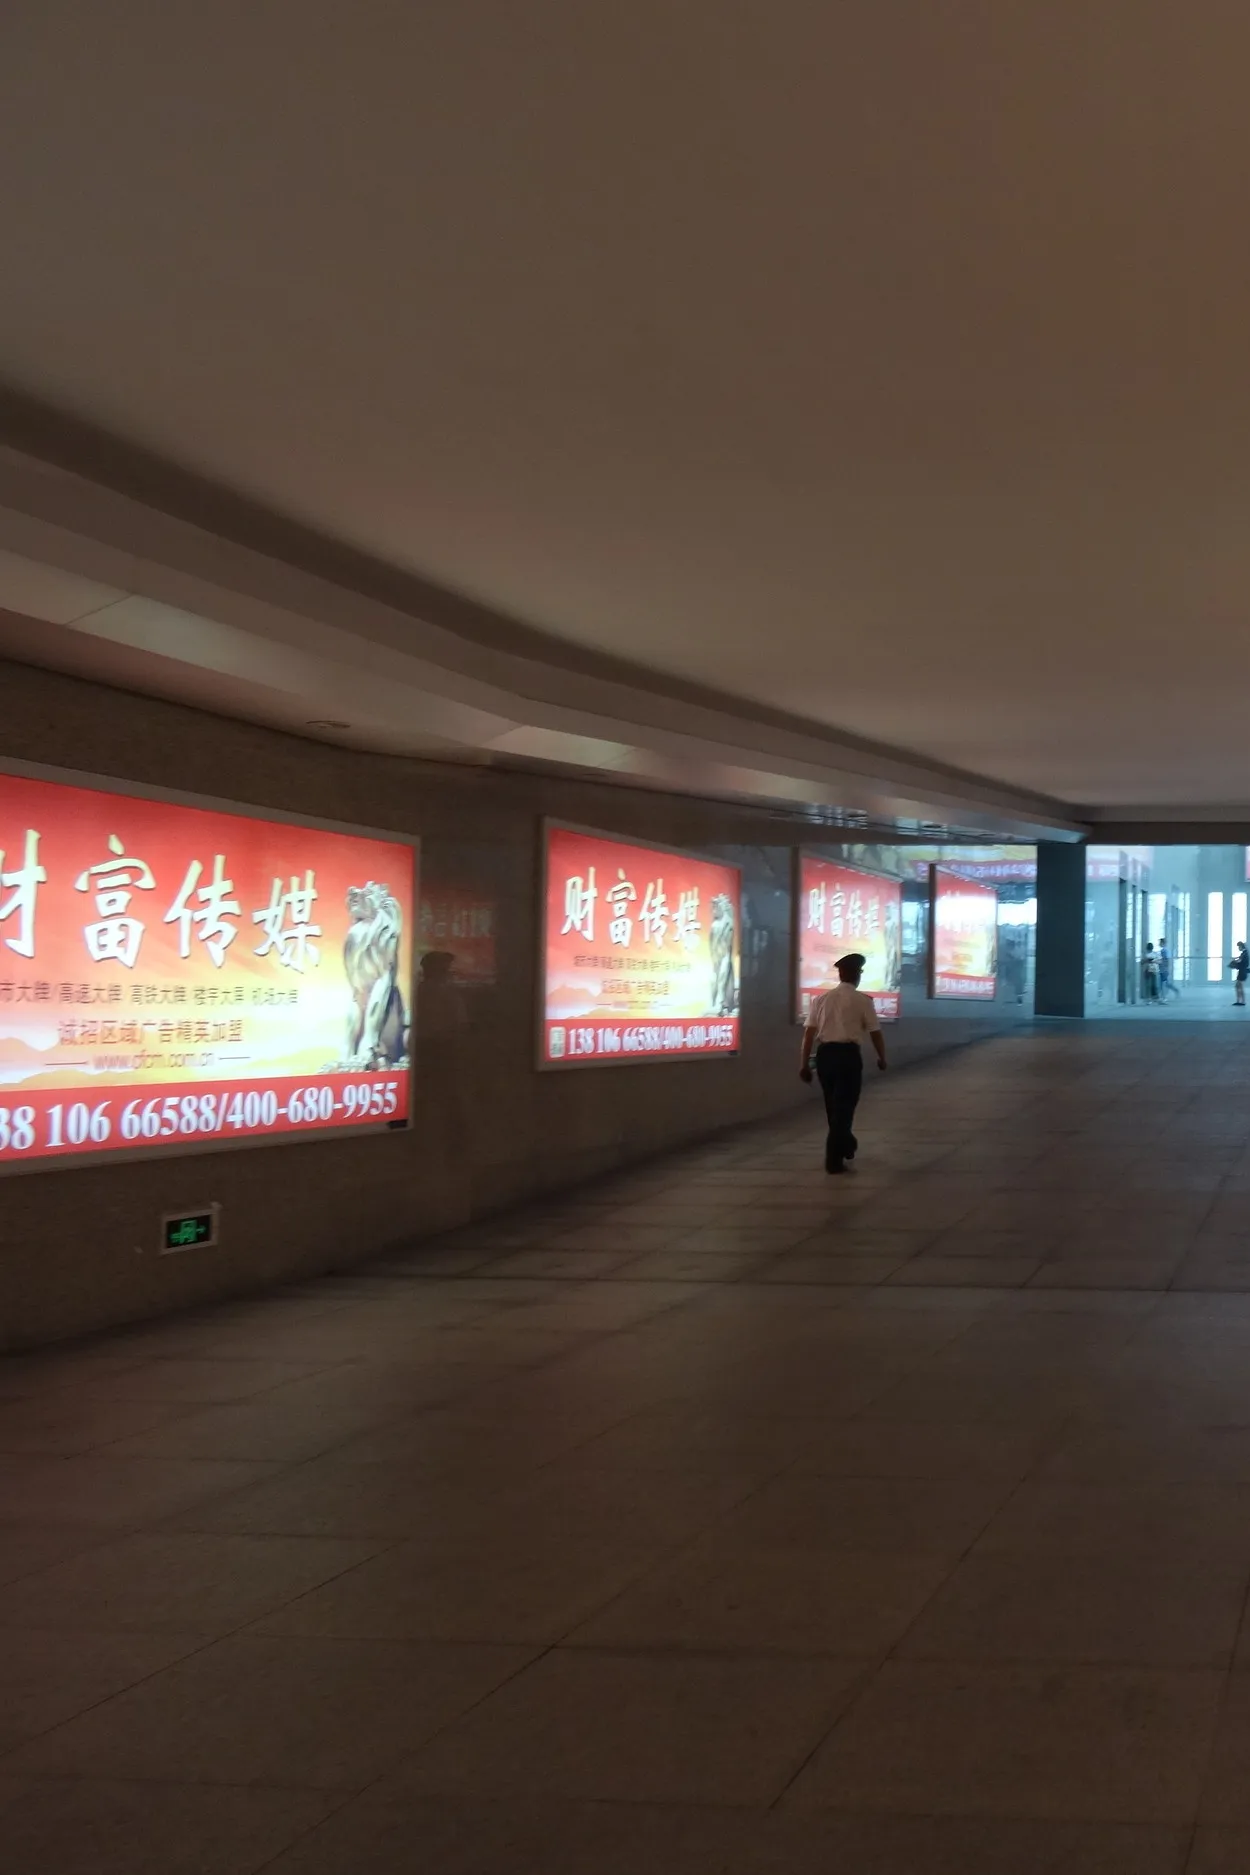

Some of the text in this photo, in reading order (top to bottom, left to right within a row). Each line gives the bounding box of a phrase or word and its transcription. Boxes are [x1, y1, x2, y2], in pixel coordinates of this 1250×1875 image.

[561, 866, 702, 952] 财富传媒
[568, 1027, 595, 1055] 138
[597, 1027, 622, 1053] 106
[45, 1101, 112, 1147] 106
[120, 1082, 398, 1140] 66588/400-680-9955
